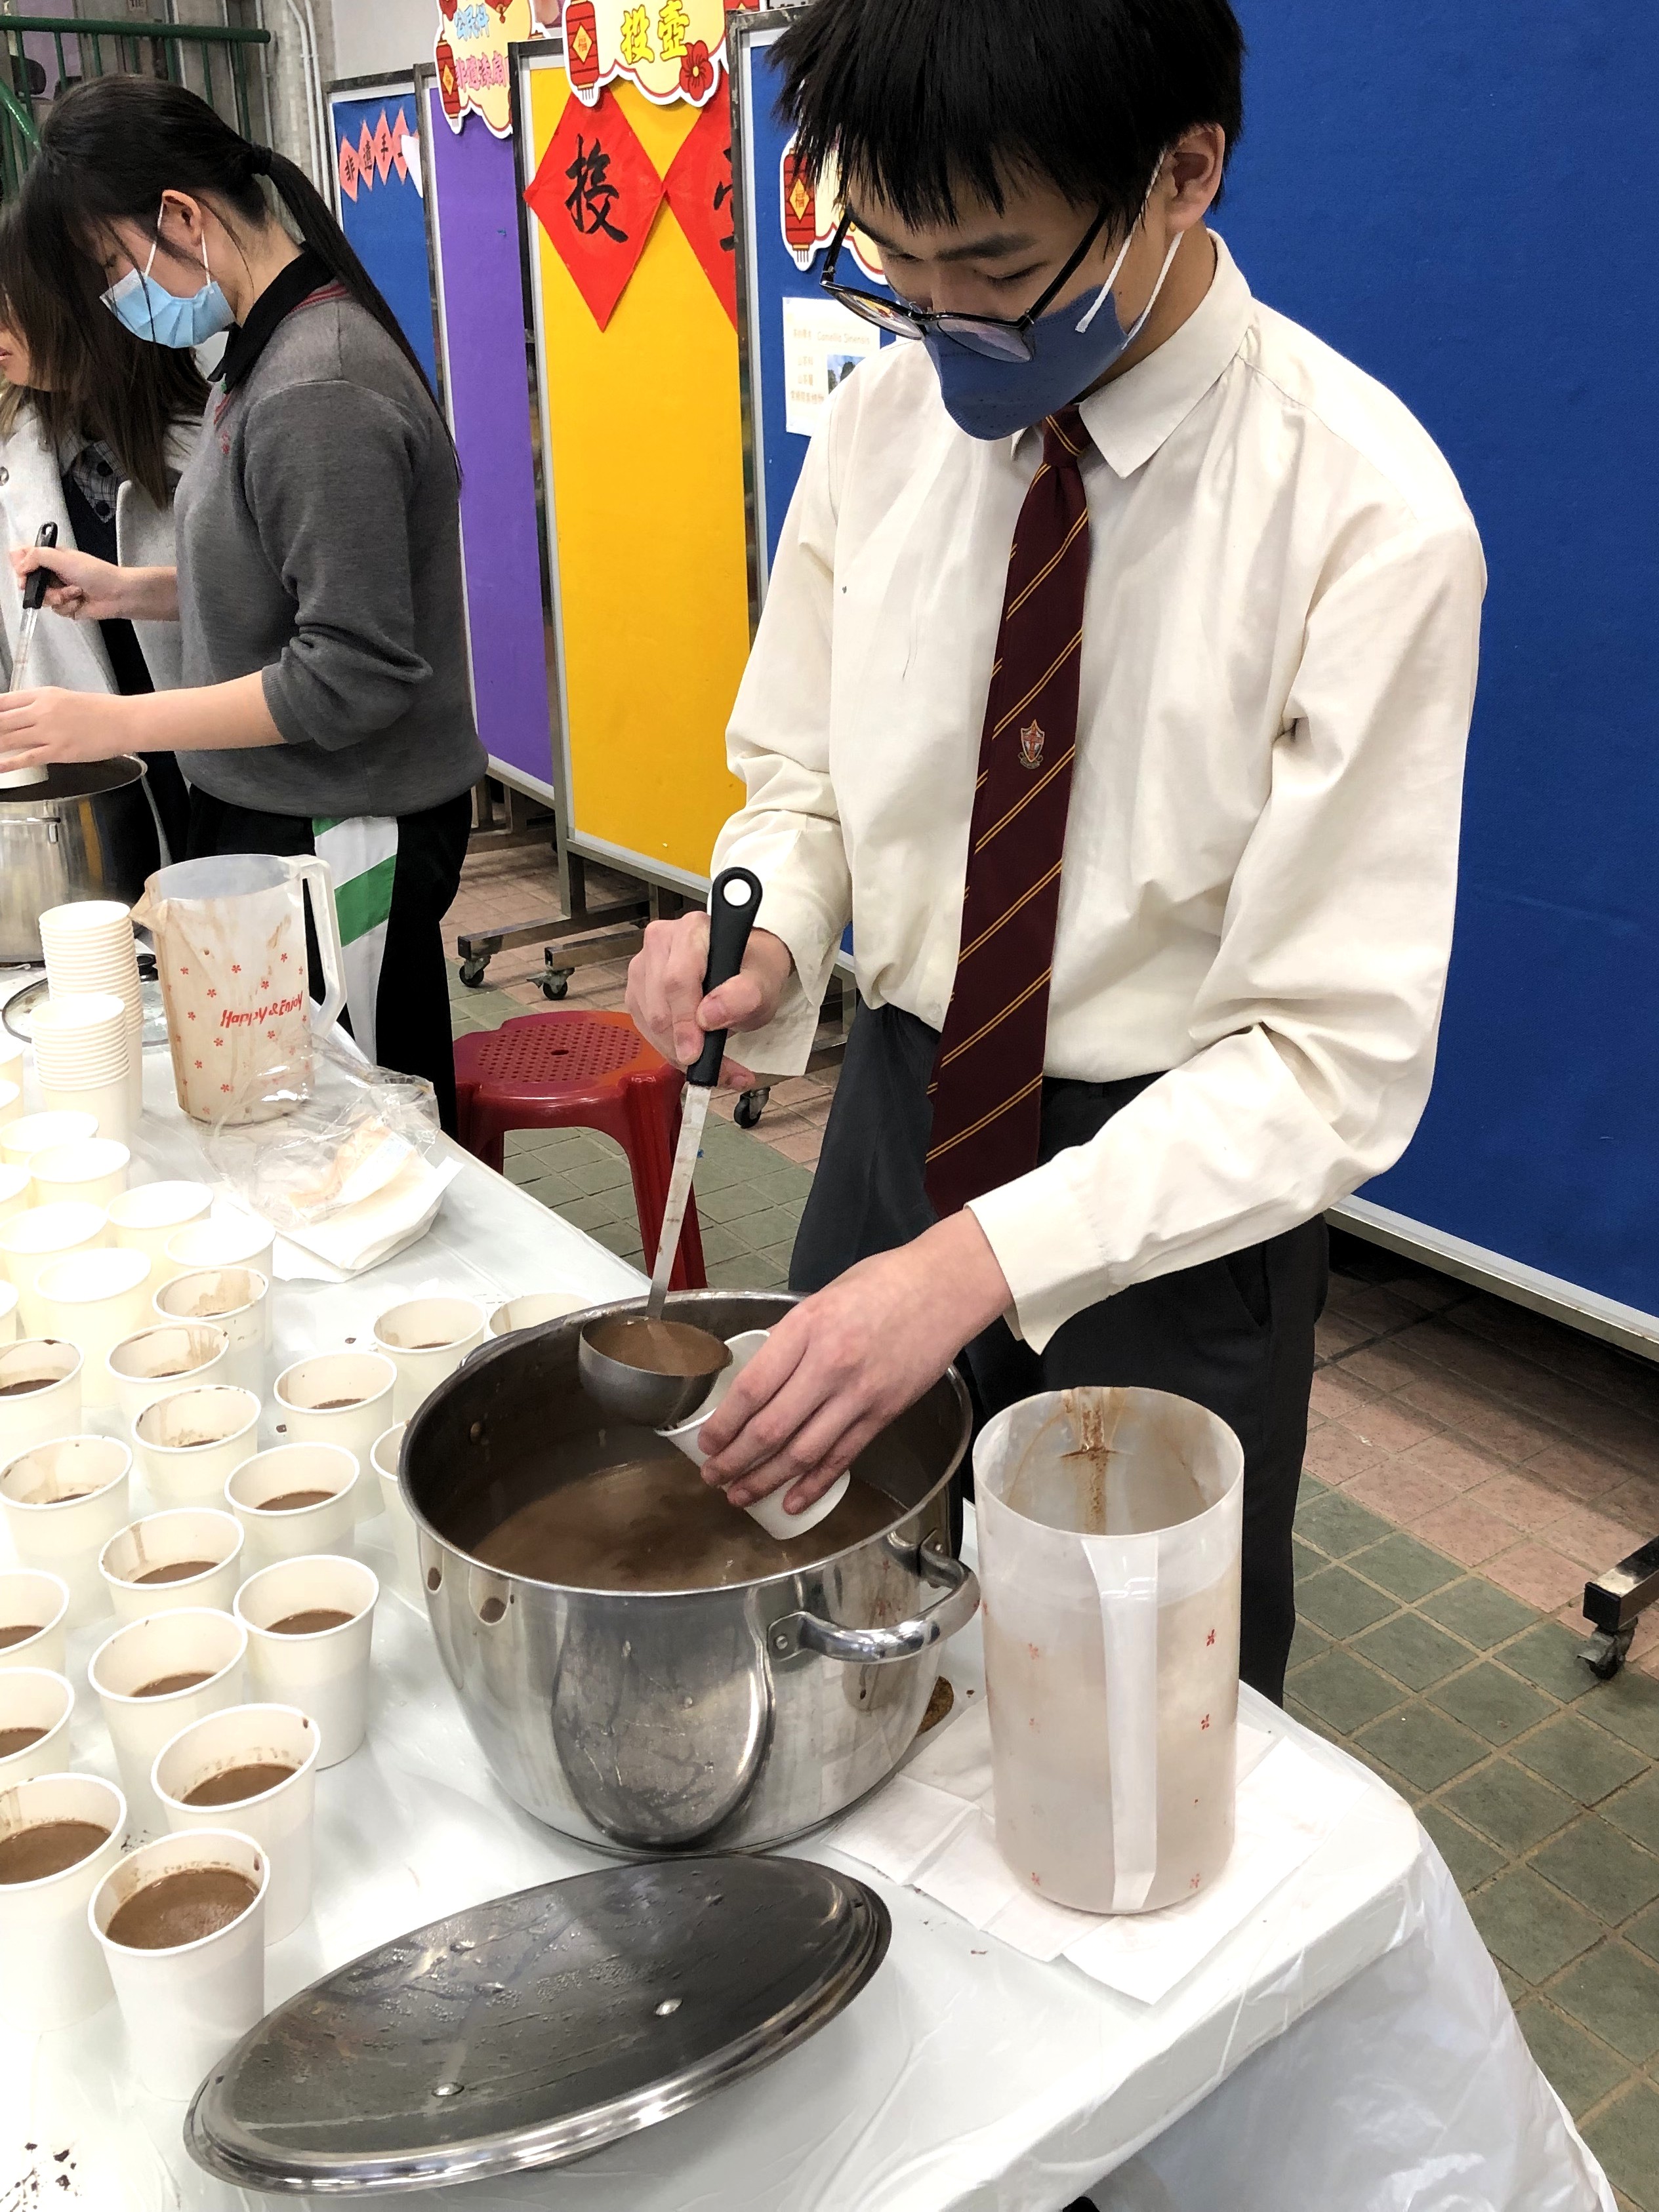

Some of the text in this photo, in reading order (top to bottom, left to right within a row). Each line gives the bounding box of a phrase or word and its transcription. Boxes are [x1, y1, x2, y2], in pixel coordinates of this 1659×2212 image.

[621, 0, 690, 65] 投壺
[455, 50, 510, 93] 非遺漆扇
[220, 990, 303, 1028] Happy & Enjoy
